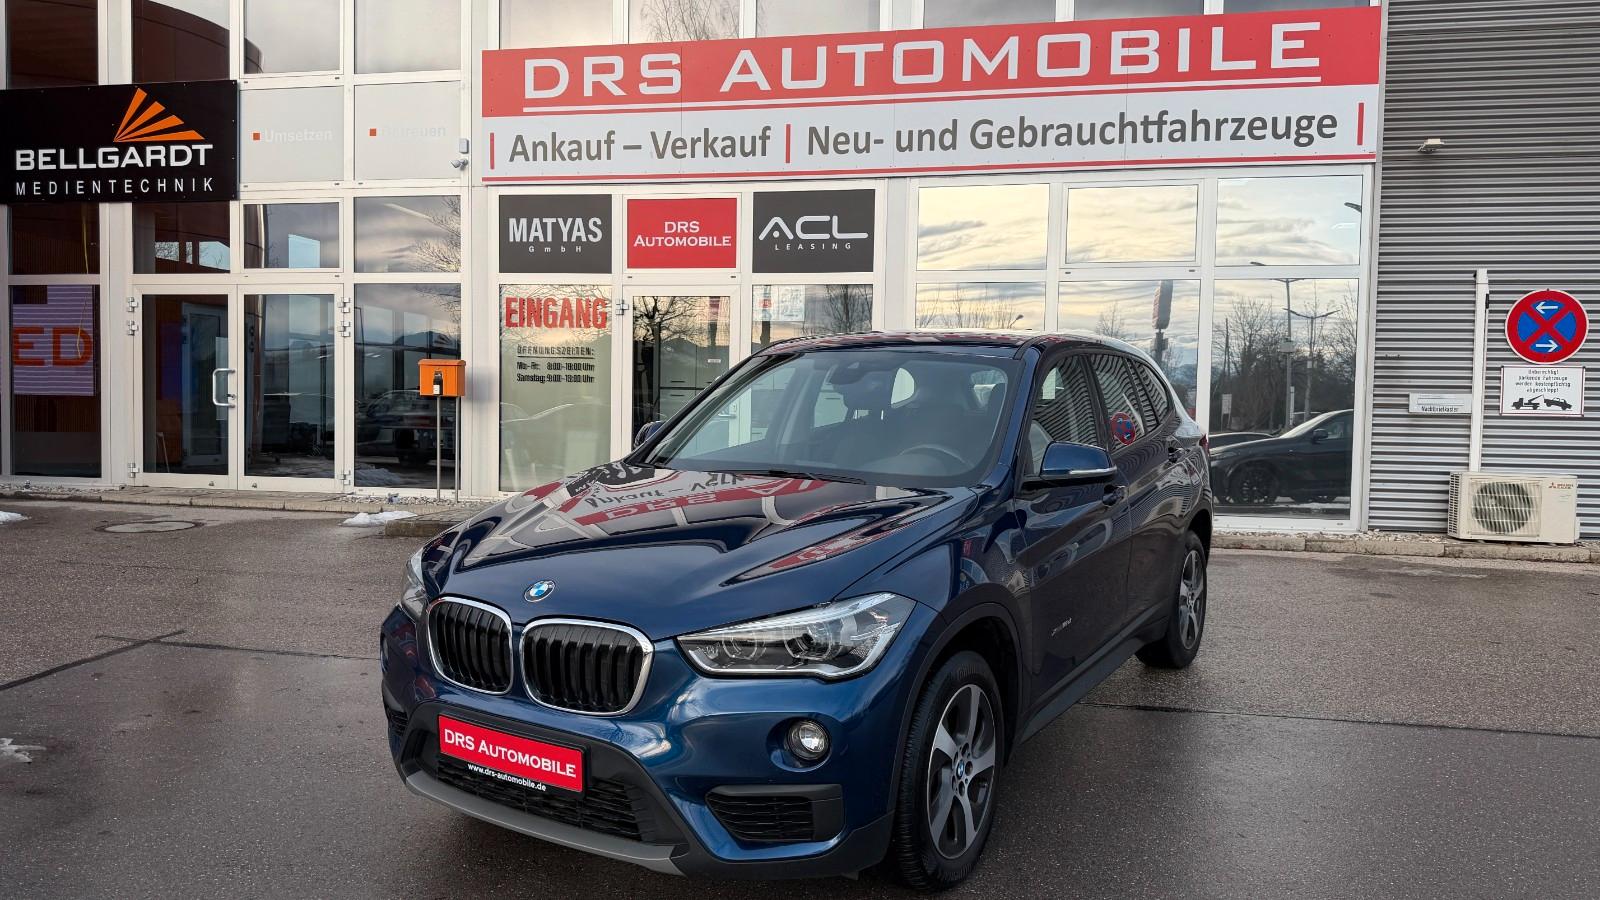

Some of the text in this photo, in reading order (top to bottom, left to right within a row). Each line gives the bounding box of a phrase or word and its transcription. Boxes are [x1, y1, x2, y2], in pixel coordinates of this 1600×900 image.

[524, 21, 1321, 99] DRS AUTOMOBILE
[264, 127, 334, 143] Umsetzen
[508, 130, 615, 163] Ankauf
[650, 126, 772, 160] Verkauf
[807, 125, 884, 156] Neu-
[895, 118, 958, 153] und
[969, 109, 1338, 149] Gebrauchtfahrzeuge
[15, 144, 214, 171] BELLGARDT
[15, 177, 213, 196] MEDIENTECHNIK
[508, 217, 603, 243] MATYAS
[664, 220, 700, 234] DRS
[774, 243, 852, 251] LEASING
[505, 297, 608, 329] EINGANG
[13, 326, 92, 367] ED
[444, 729, 475, 751] DRS
[467, 763, 547, 792] www.drs-automobile.de
